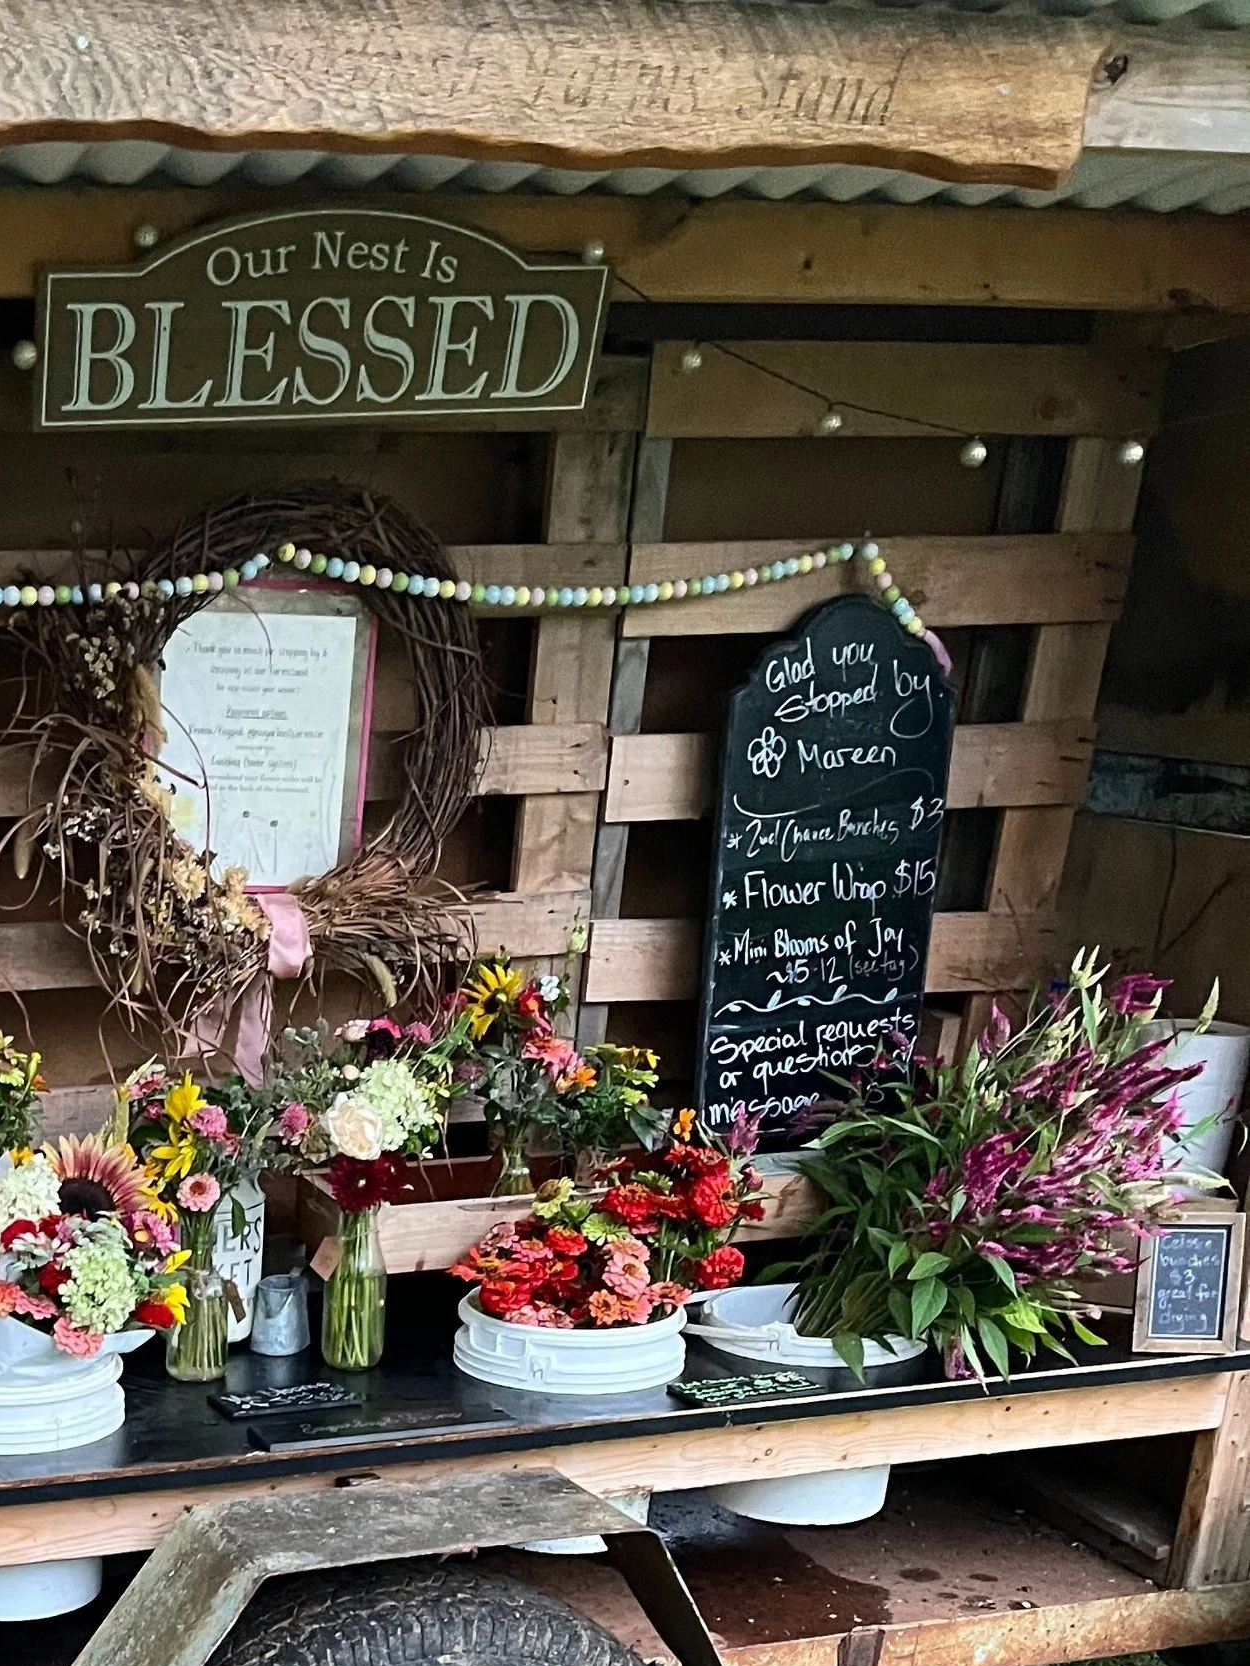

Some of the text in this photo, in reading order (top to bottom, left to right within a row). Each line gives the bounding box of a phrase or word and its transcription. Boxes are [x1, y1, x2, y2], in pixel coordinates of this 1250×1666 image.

[206, 231, 458, 286] Our Nest Is
[61, 296, 581, 415] BLESSED
[765, 637, 876, 693] Glad you
[908, 795, 944, 832] $3
[744, 870, 827, 909] Flower
[892, 858, 935, 896] $15
[733, 928, 767, 965] Mini
[774, 929, 829, 958] Blooms
[833, 920, 857, 954] of
[710, 1021, 807, 1066] Special
[816, 1006, 916, 1054] requests
[719, 1071, 743, 1089] or
